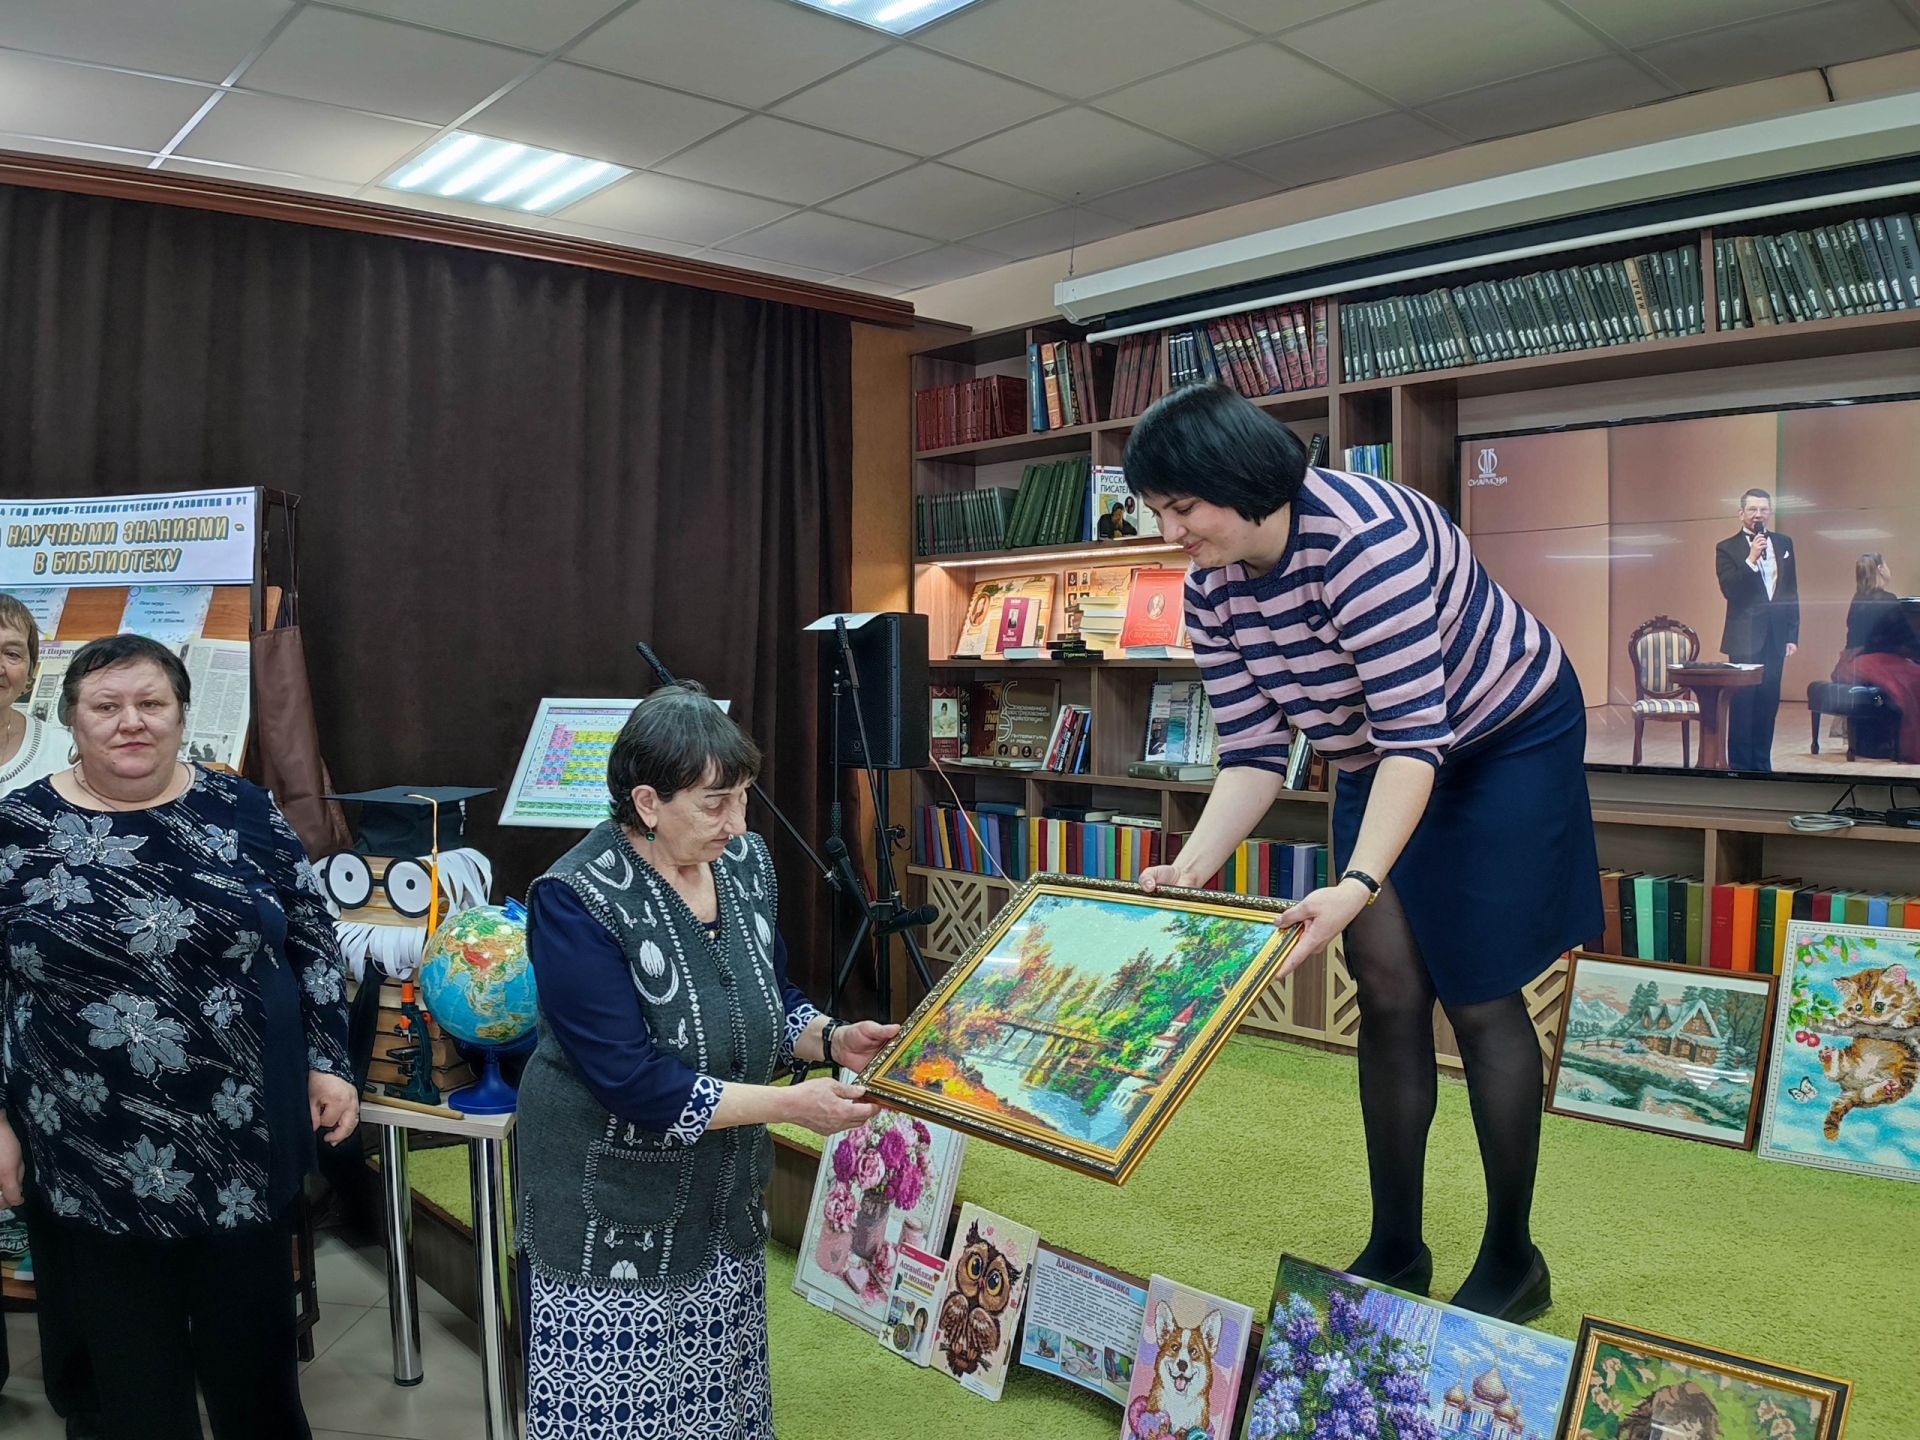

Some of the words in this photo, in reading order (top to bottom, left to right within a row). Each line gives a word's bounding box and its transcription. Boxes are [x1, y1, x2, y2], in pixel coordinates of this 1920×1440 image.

[1631, 279, 1646, 310] МАРАТ
[1100, 475, 1126, 484] РУССКИ
[1100, 484, 1130, 494] ПИСАТЕЛ
[10, 507, 29, 517] ГОД
[173, 498, 222, 509] РАЗВИТИЯ
[236, 496, 247, 505] РТ
[6, 521, 118, 547] НАУЧНЫМИ
[123, 516, 229, 544] ЗНАНИЯМИ
[33, 552, 48, 575] В
[51, 548, 182, 575] БИБЛИОТЕКУ
[0, 1238, 30, 1250] ЖИДК
[1056, 1258, 1093, 1280] Алмазная
[1094, 1273, 1130, 1296] вышивка
